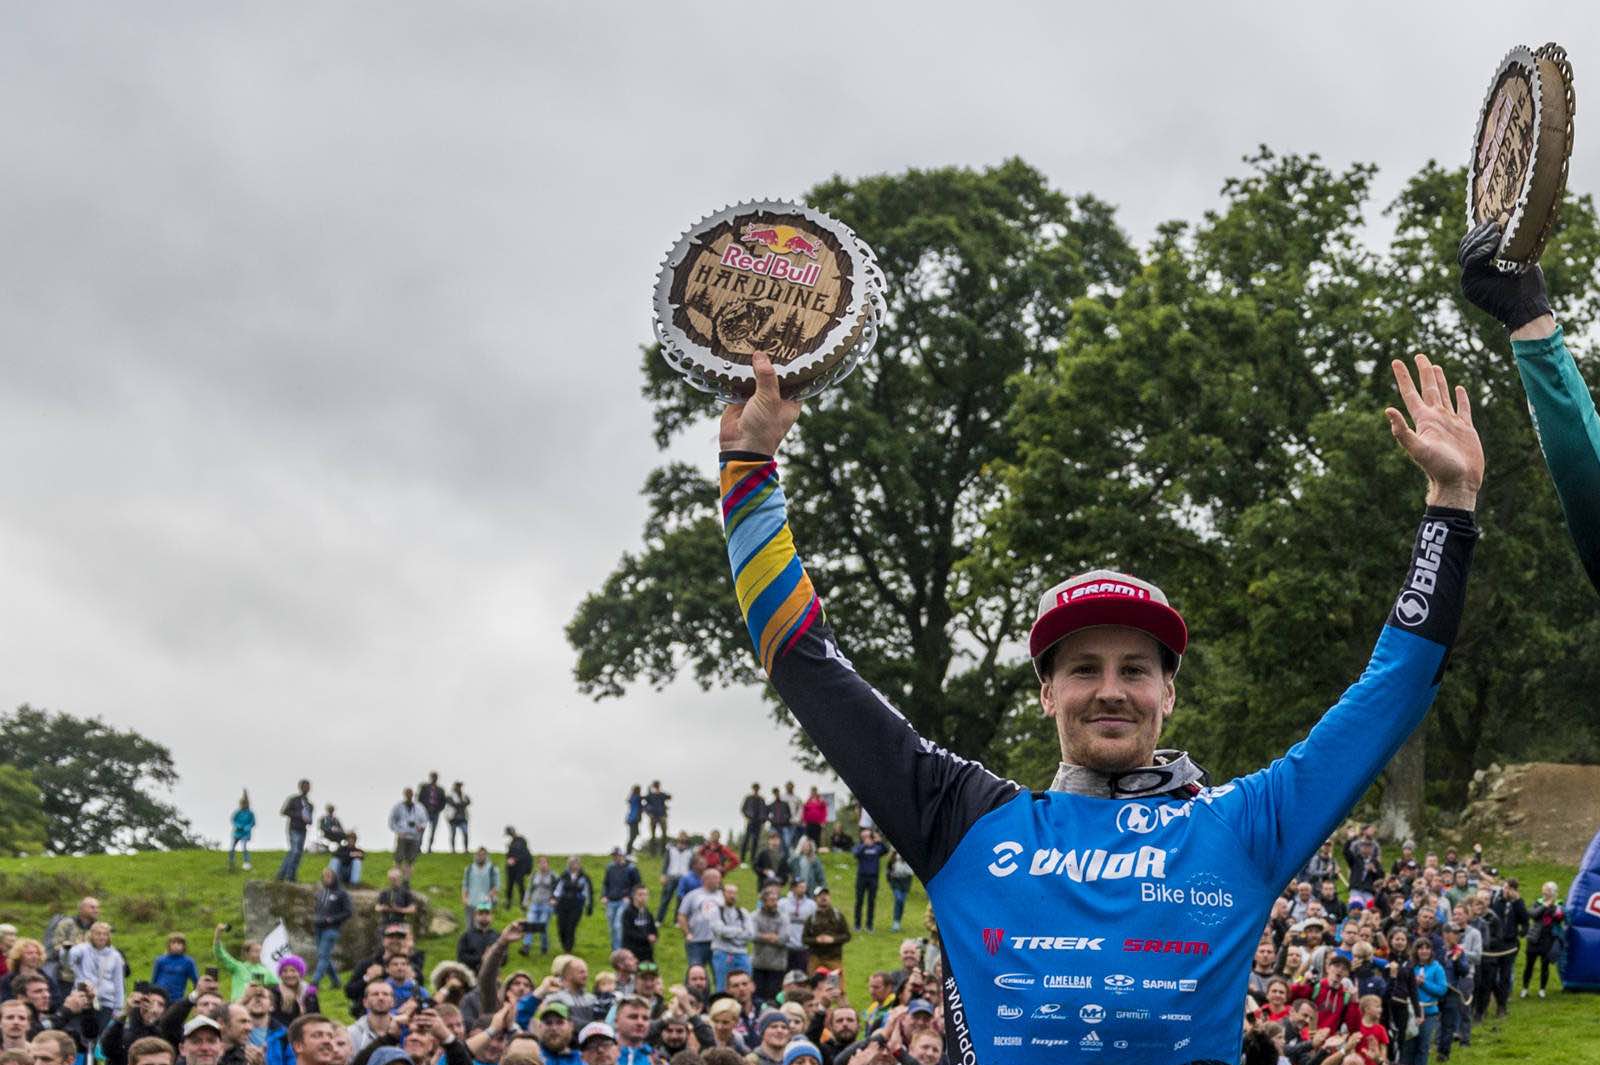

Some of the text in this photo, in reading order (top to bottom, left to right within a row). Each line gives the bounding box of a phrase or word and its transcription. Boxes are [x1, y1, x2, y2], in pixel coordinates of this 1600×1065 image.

[694, 264, 831, 313] HARDLINE
[767, 339, 799, 360] 2ND
[1070, 582, 1136, 600] SRAM
[1028, 844, 1167, 884] UNIOR
[1141, 882, 1234, 908] Bike tools
[1010, 936, 1106, 951] TREK
[1122, 938, 1210, 955] SRAM
[1042, 974, 1093, 989] CAMELBAK
[1142, 979, 1178, 990] SAPIM
[1079, 1039, 1104, 1047] adidas
